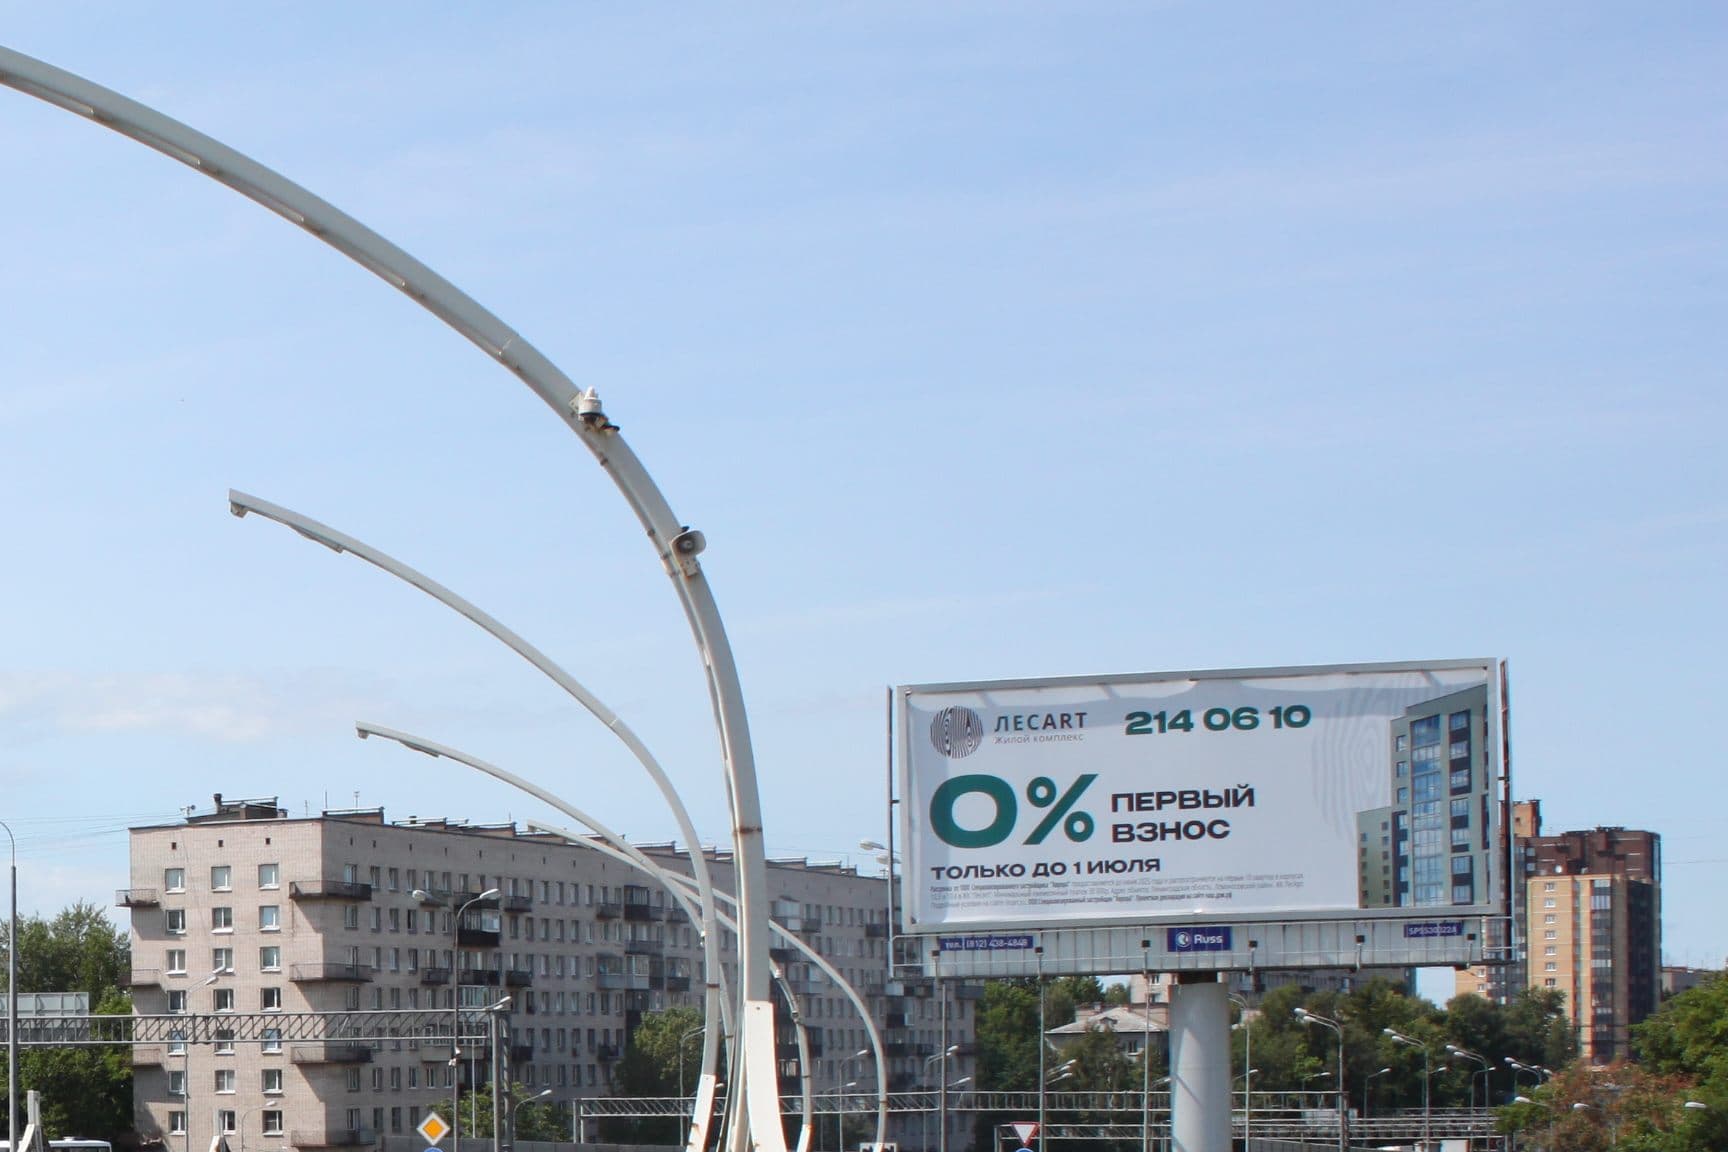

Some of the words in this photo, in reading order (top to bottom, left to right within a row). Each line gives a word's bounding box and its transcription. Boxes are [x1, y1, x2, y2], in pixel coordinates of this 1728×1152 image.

[993, 712, 1088, 732] ЛЕСART
[1124, 708, 1194, 735] 214
[1203, 706, 1260, 731] 06
[1268, 704, 1312, 729] 10
[1032, 733, 1084, 743] комплекс
[1111, 784, 1255, 813] ПЕРВЫЙ
[929, 773, 1099, 849] 0%
[1111, 819, 1231, 843] ВЗНОС
[931, 863, 1026, 880] ТОЛЬКО
[1032, 862, 1067, 877] ДО
[1073, 861, 1081, 874] 1
[1087, 858, 1161, 874] ИЮЛЯ
[1194, 934, 1224, 945] Russ
